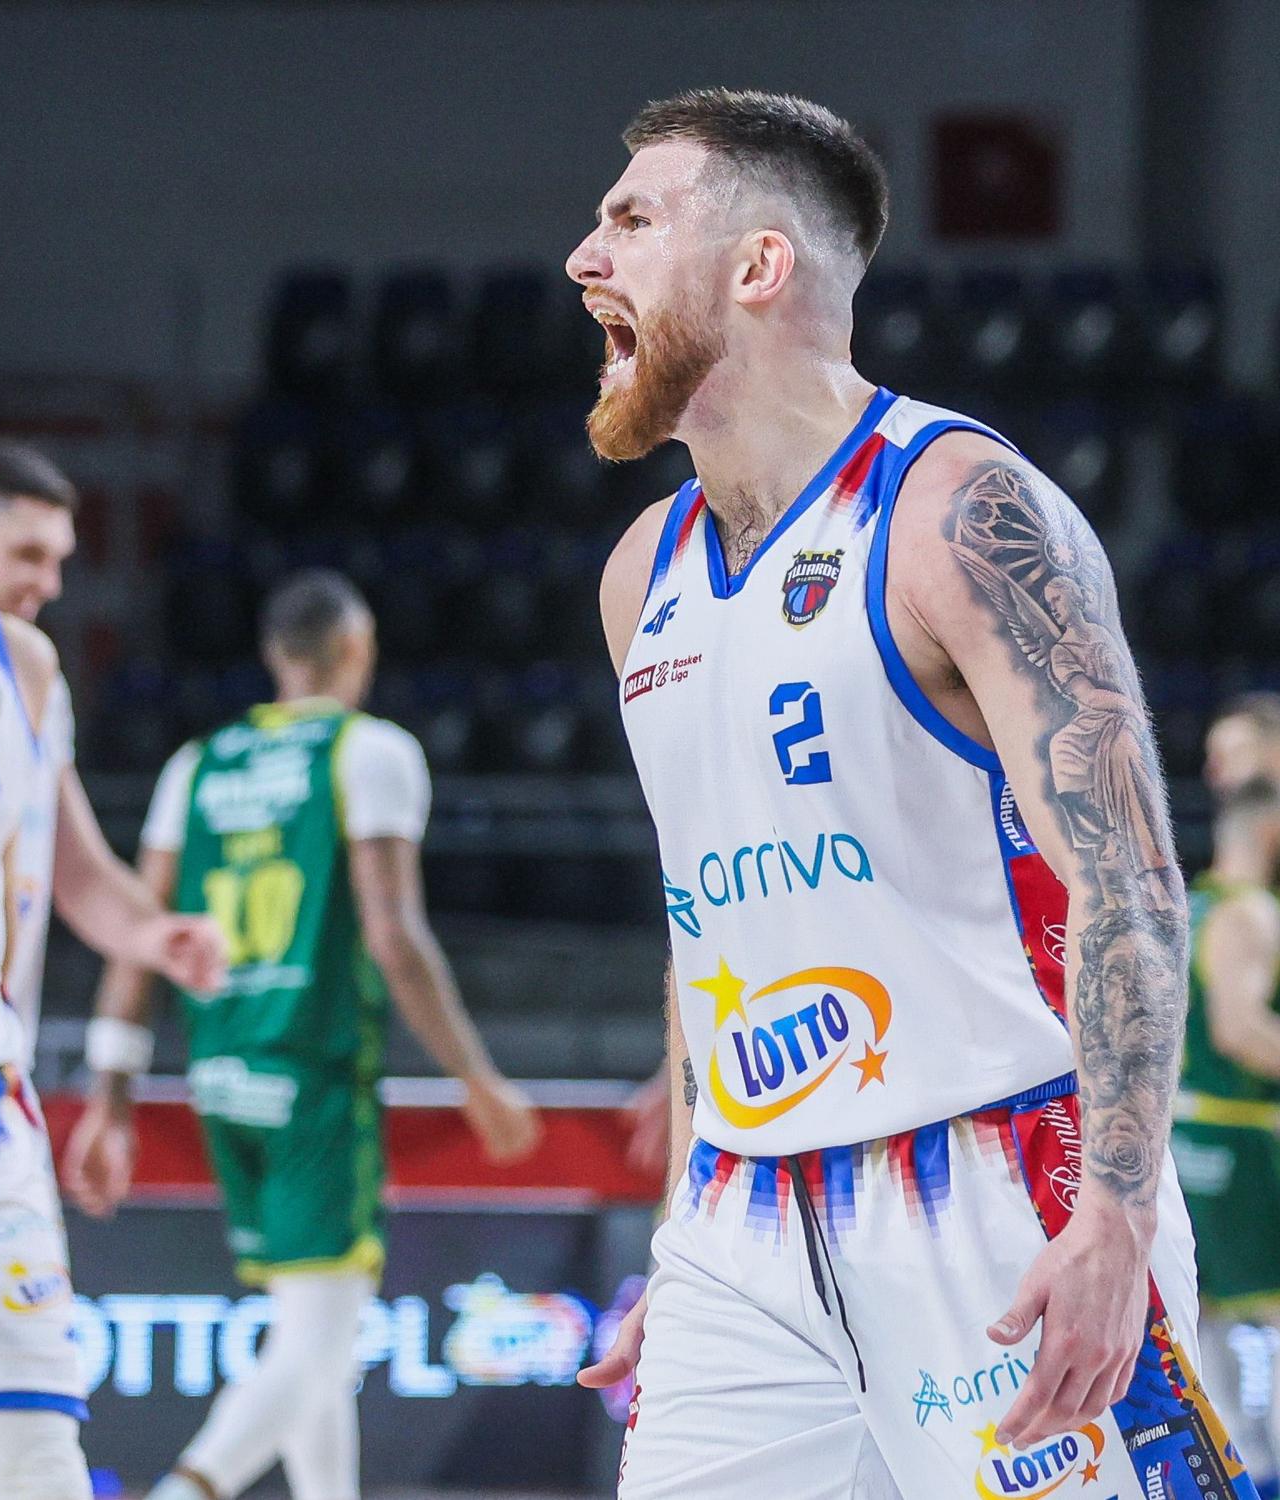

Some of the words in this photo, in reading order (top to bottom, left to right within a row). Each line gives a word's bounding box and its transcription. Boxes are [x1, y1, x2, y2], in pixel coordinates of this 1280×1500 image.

[787, 563, 840, 584] TWARDE
[625, 669, 653, 700] ORLEN
[670, 670, 689, 683] Liga
[672, 653, 702, 669] Basket
[768, 681, 832, 785] 2
[699, 825, 874, 908] arriva
[731, 993, 849, 1098] LOTTO
[953, 1350, 1040, 1406] arriv
[991, 1435, 1079, 1493] LOTTO
